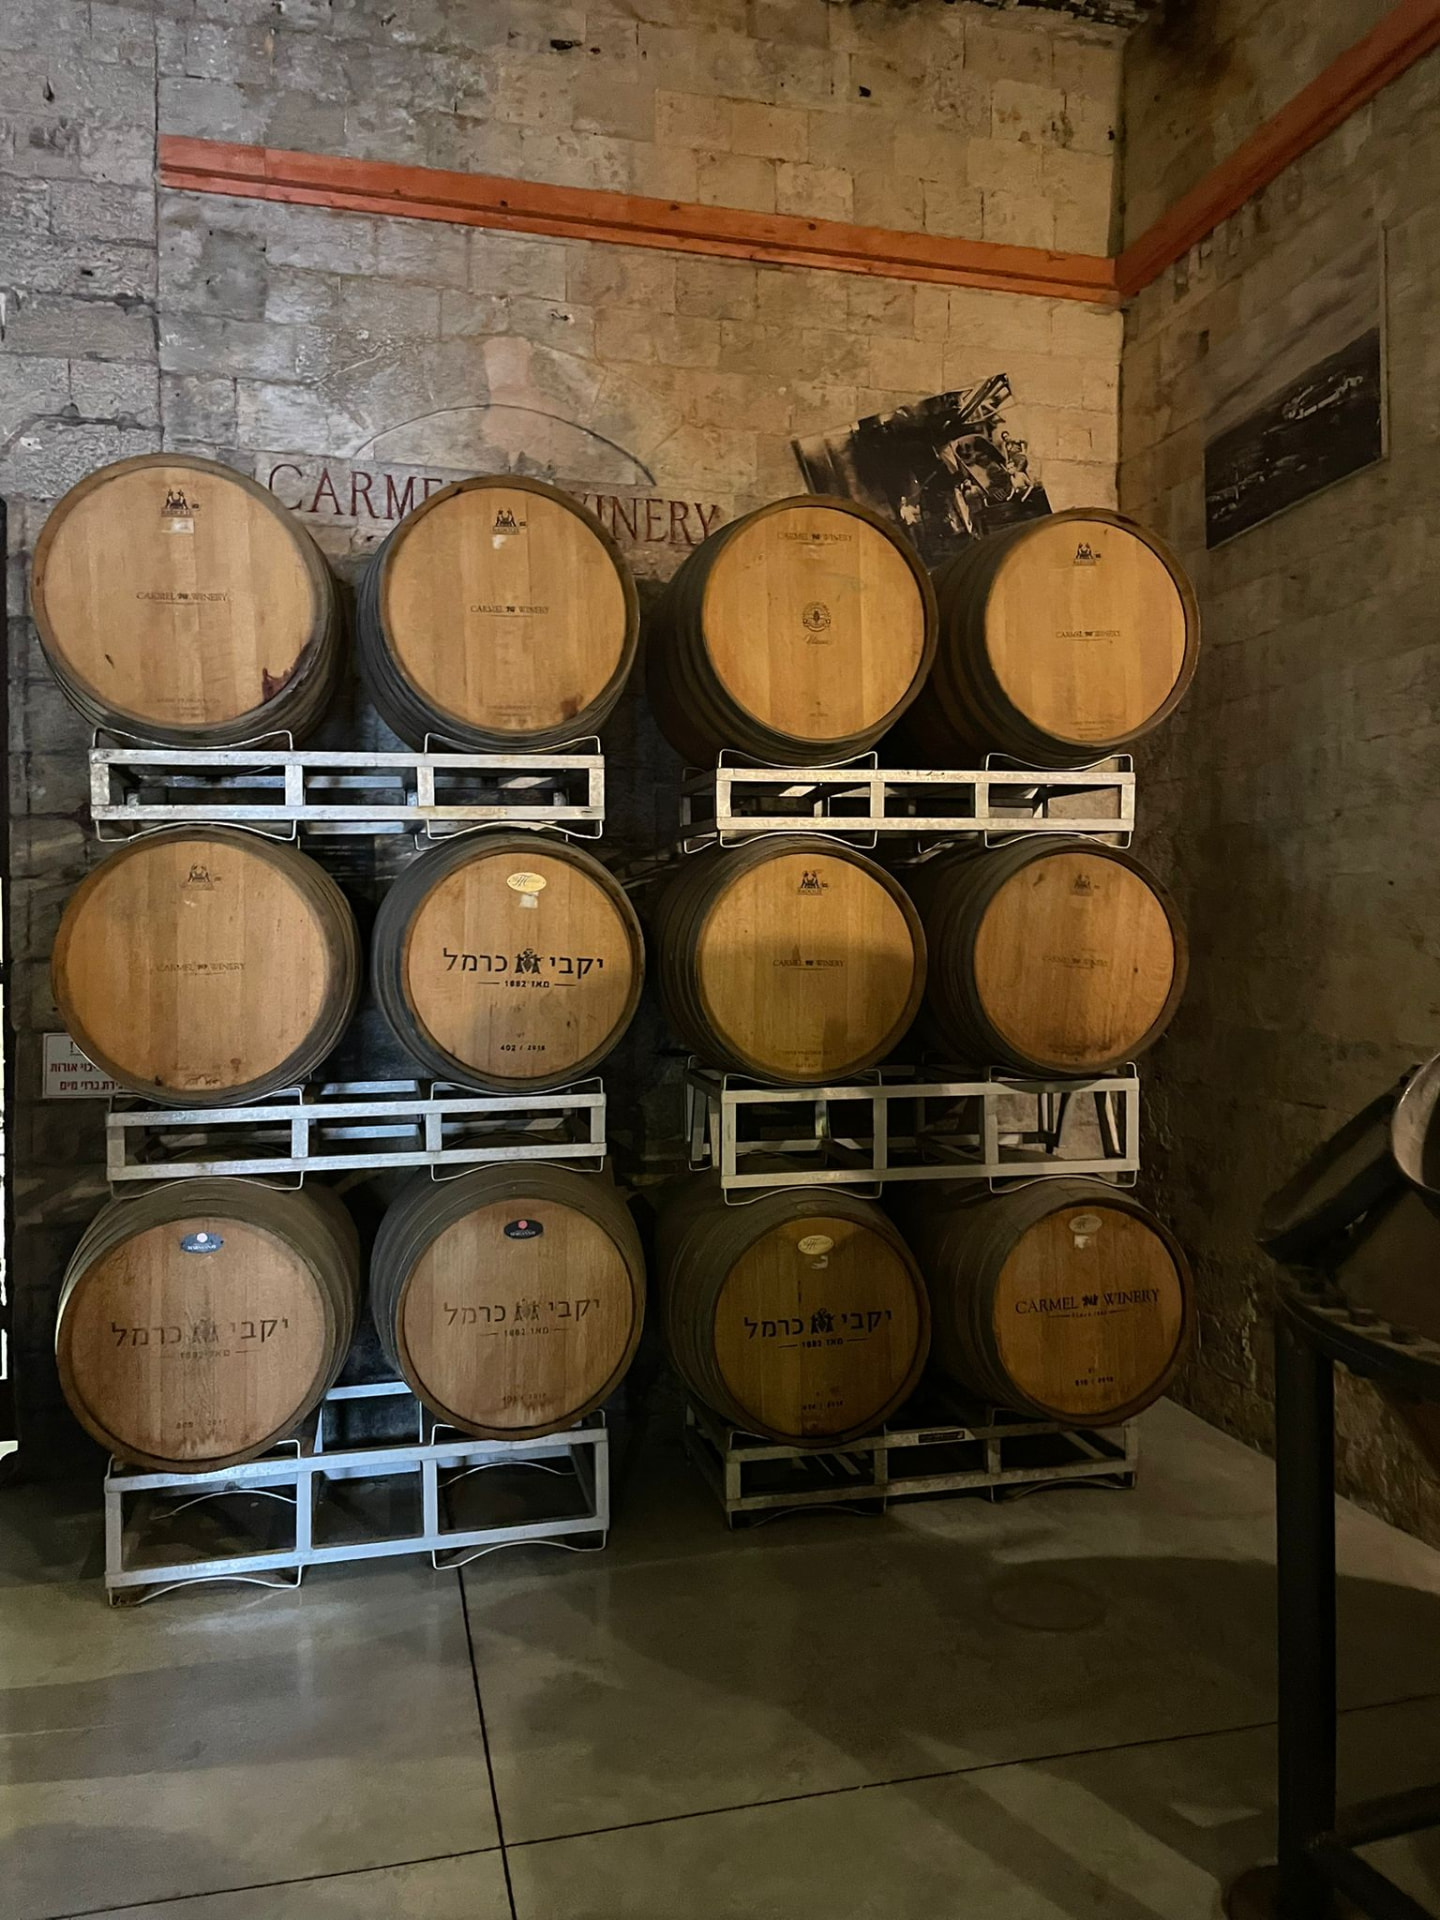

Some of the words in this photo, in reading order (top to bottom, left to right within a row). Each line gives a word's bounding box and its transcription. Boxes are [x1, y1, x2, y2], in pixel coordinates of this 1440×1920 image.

[268, 463, 460, 521] CARM
[570, 490, 719, 546] INERY
[443, 947, 508, 973] כרמל
[549, 956, 604, 979] יקבי
[530, 980, 551, 989] מאז
[49, 1063, 78, 1072] אורות
[60, 1081, 78, 1091] מים
[547, 1298, 600, 1322] יקבי
[1015, 1296, 1079, 1315] CARMEL
[1103, 1287, 1159, 1306] WINERY
[443, 1302, 506, 1326] כרמל
[841, 1310, 892, 1333] יקבי
[111, 1322, 183, 1347] כרמל
[228, 1317, 289, 1343] יקבי
[744, 1317, 804, 1339] כרמל
[826, 1337, 844, 1346] מאז
